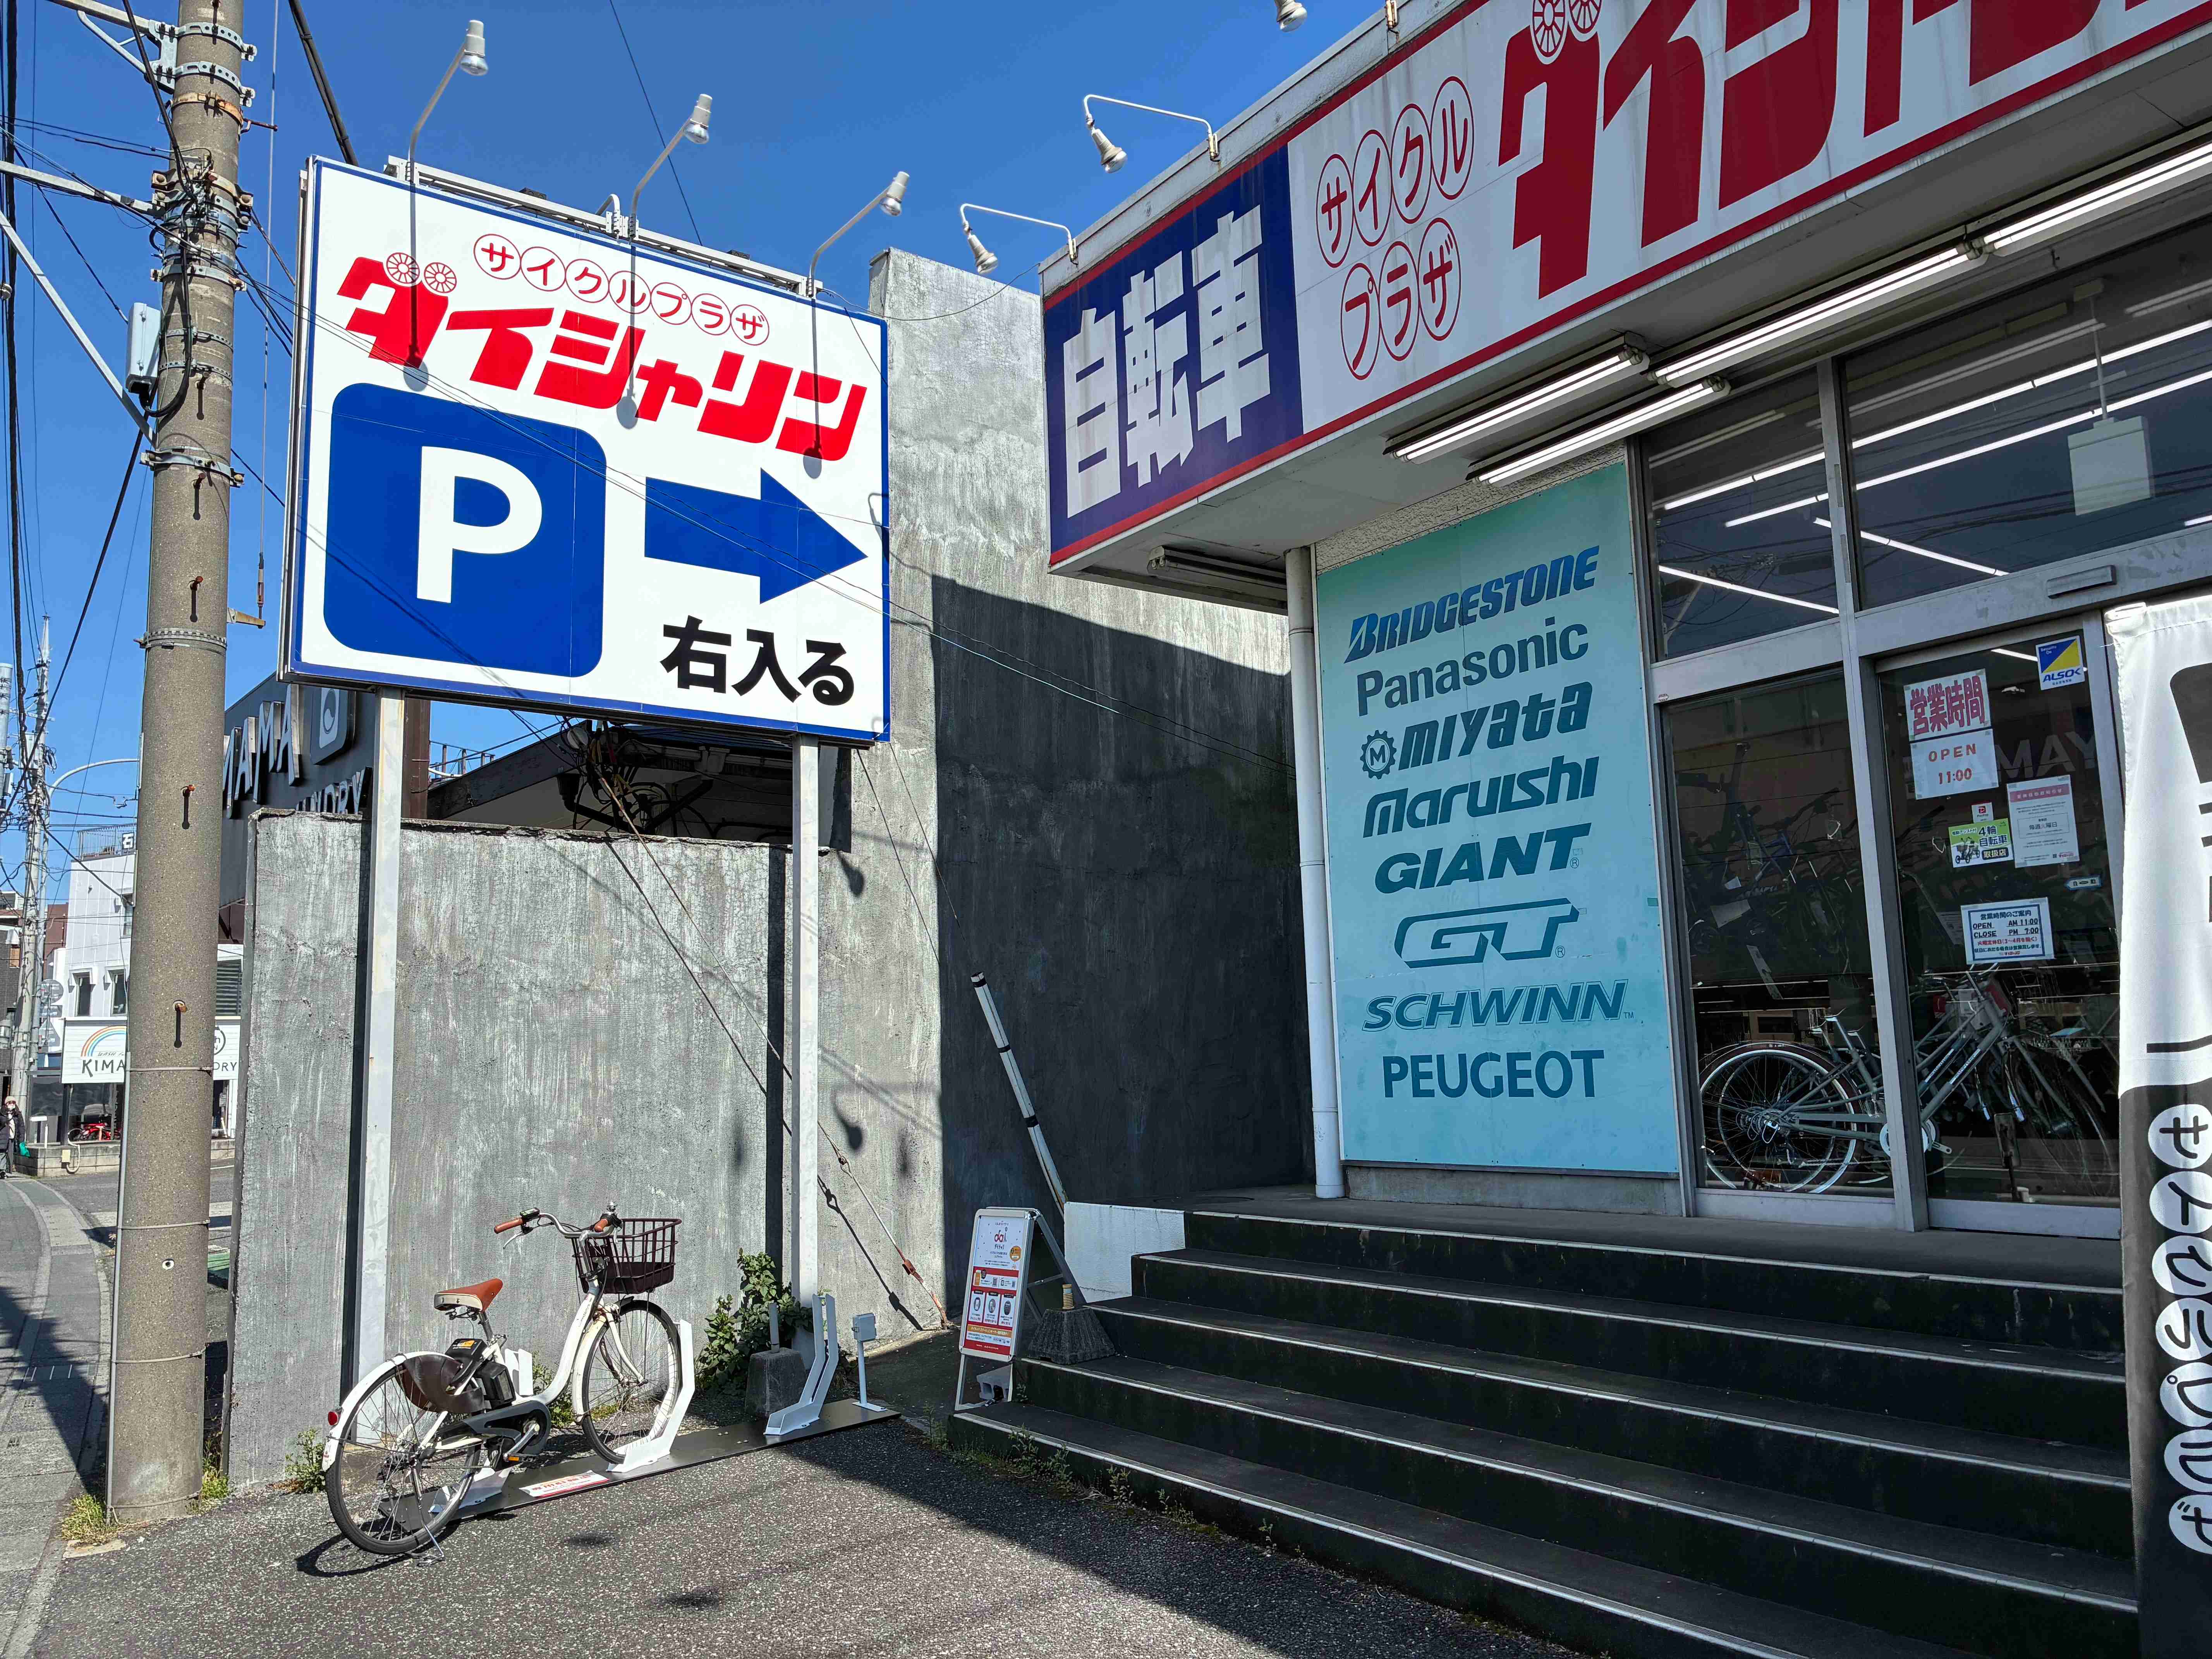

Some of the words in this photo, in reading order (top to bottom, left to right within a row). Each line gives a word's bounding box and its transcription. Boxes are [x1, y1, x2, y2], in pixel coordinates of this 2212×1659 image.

[1321, 98, 1468, 255] サイクル
[479, 239, 767, 342] サイクルプラザ
[1345, 232, 1453, 371] プラザ
[338, 252, 867, 461] ダイシャリン
[1063, 205, 1271, 518] 自転車
[416, 445, 543, 603] P
[1343, 545, 1600, 664] BRIDGESTONE
[659, 614, 855, 706] 右入る
[1357, 616, 1589, 716] Panasonic
[2043, 668, 2081, 682] ALSOK
[1910, 675, 1985, 735] 営業時間
[1928, 743, 1976, 762] OPEN
[1939, 768, 1972, 785] 11:00
[1375, 823, 1592, 894] GIANT
[1978, 825, 1997, 836] 4輪
[1979, 835, 2008, 847] 自転車
[1984, 849, 2006, 858] 取扱店
[1394, 898, 1580, 969] GT
[1980, 910, 2032, 920] 営業時間のご案内
[1362, 979, 1628, 1032] SCHWINN
[1382, 1049, 1604, 1099] PEUGEOT
